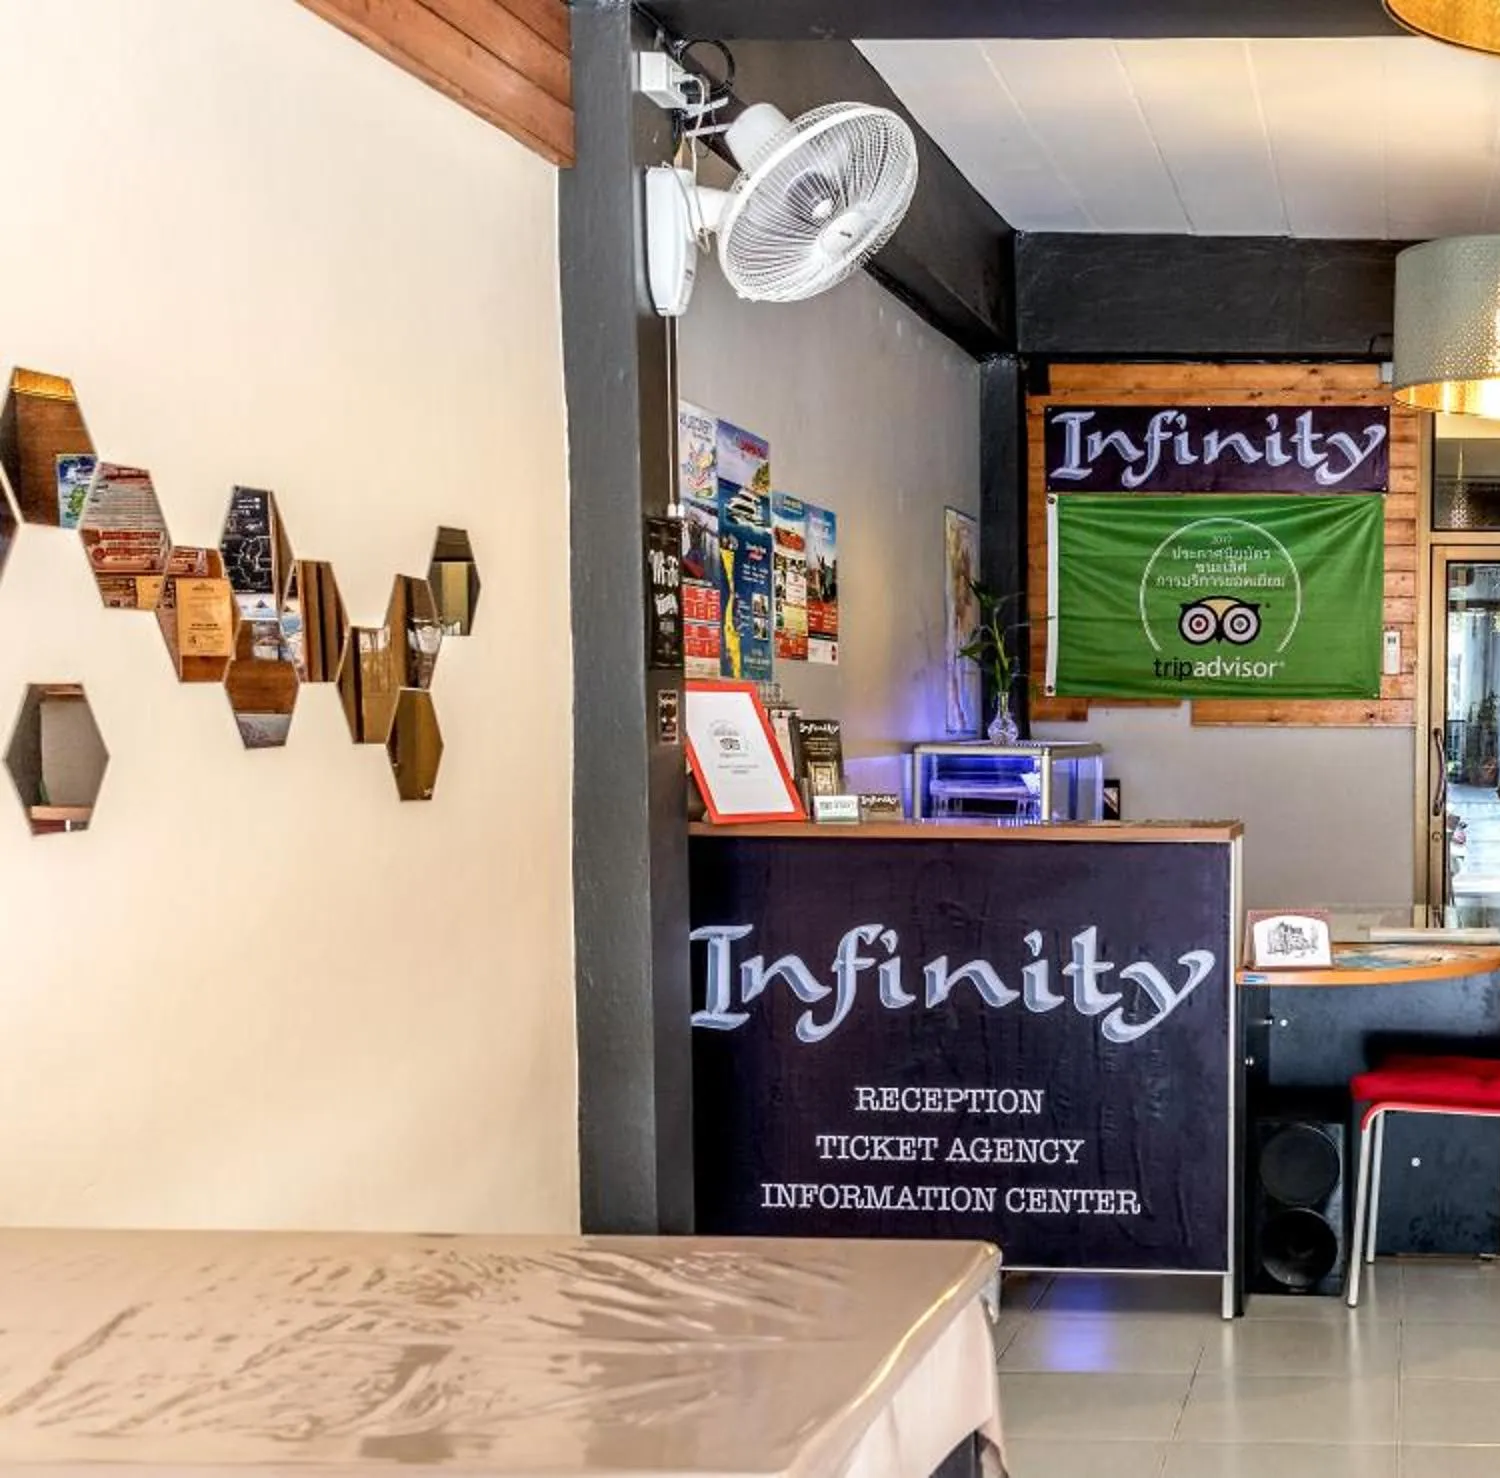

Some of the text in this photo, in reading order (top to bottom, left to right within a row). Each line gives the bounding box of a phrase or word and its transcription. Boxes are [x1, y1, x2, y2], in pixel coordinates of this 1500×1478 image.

[1050, 409, 1387, 489] Infinity
[1152, 655, 1279, 682] tripadvisor
[689, 923, 1217, 1044] Infinity
[854, 1087, 1045, 1114] RECEPTION
[816, 1135, 1085, 1164] TICKET AGENCY
[761, 1183, 1142, 1216] INFORMATION CENTER
